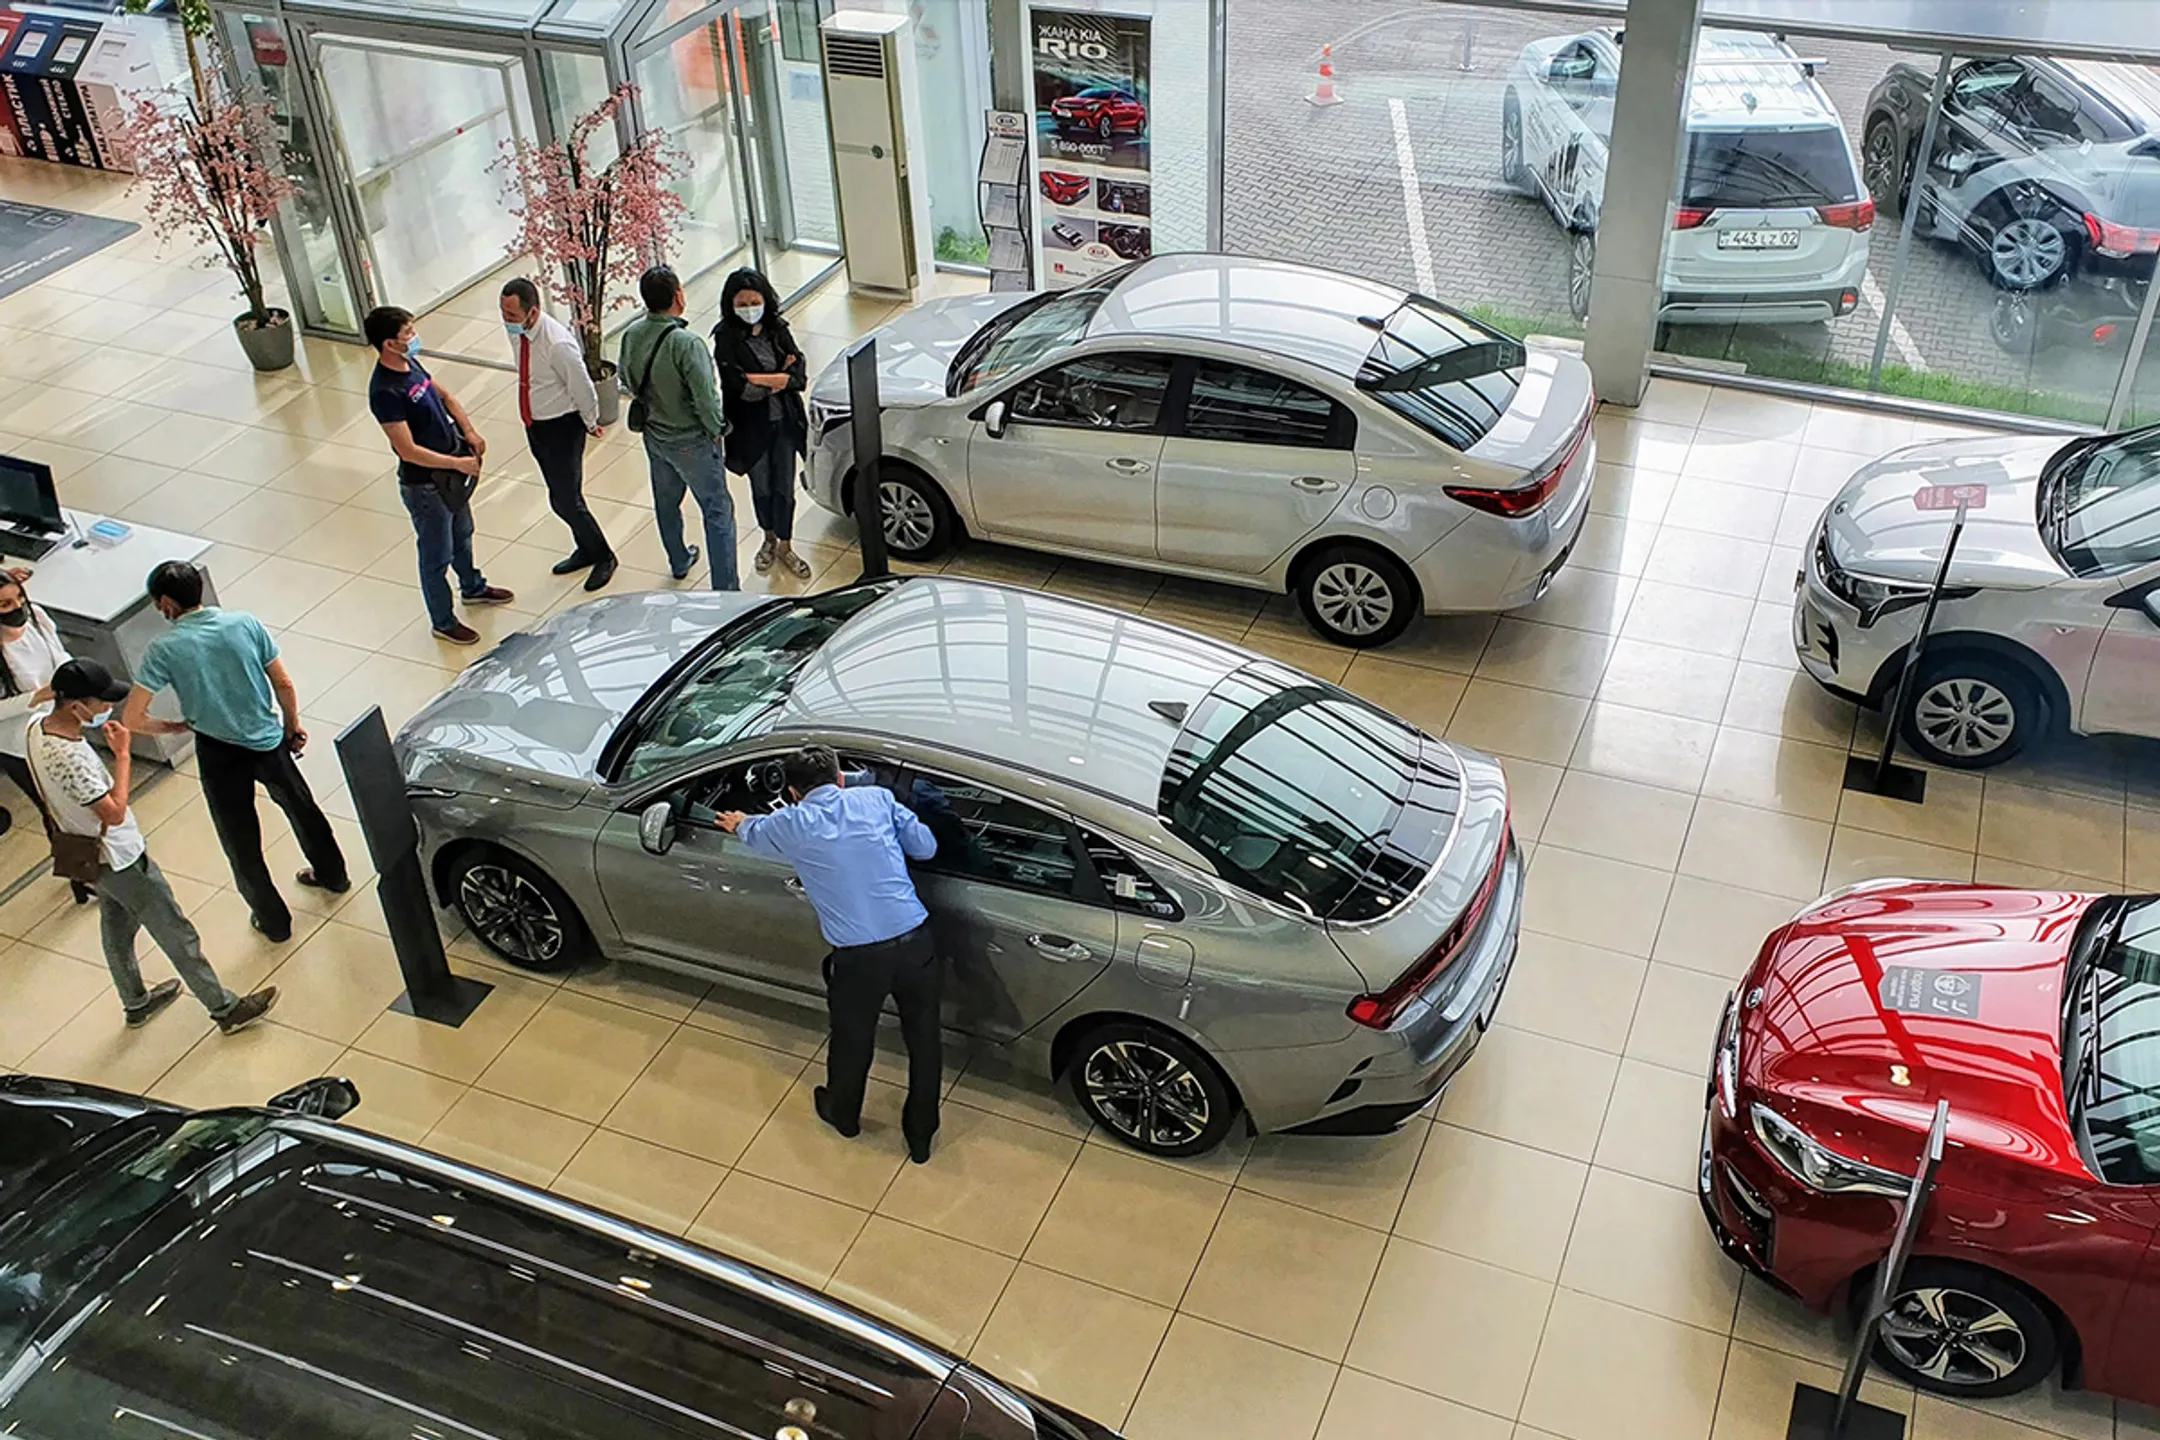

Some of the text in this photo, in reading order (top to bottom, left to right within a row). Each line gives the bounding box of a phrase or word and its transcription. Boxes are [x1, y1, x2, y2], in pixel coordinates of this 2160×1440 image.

[1080, 28, 1102, 42] KIA
[1039, 37, 1107, 60] RIO
[2, 73, 33, 137] ПЛАСТИК
[52, 80, 72, 119] СТЕКЛО
[1733, 232, 1757, 244] 443
[1780, 232, 1798, 244] 02
